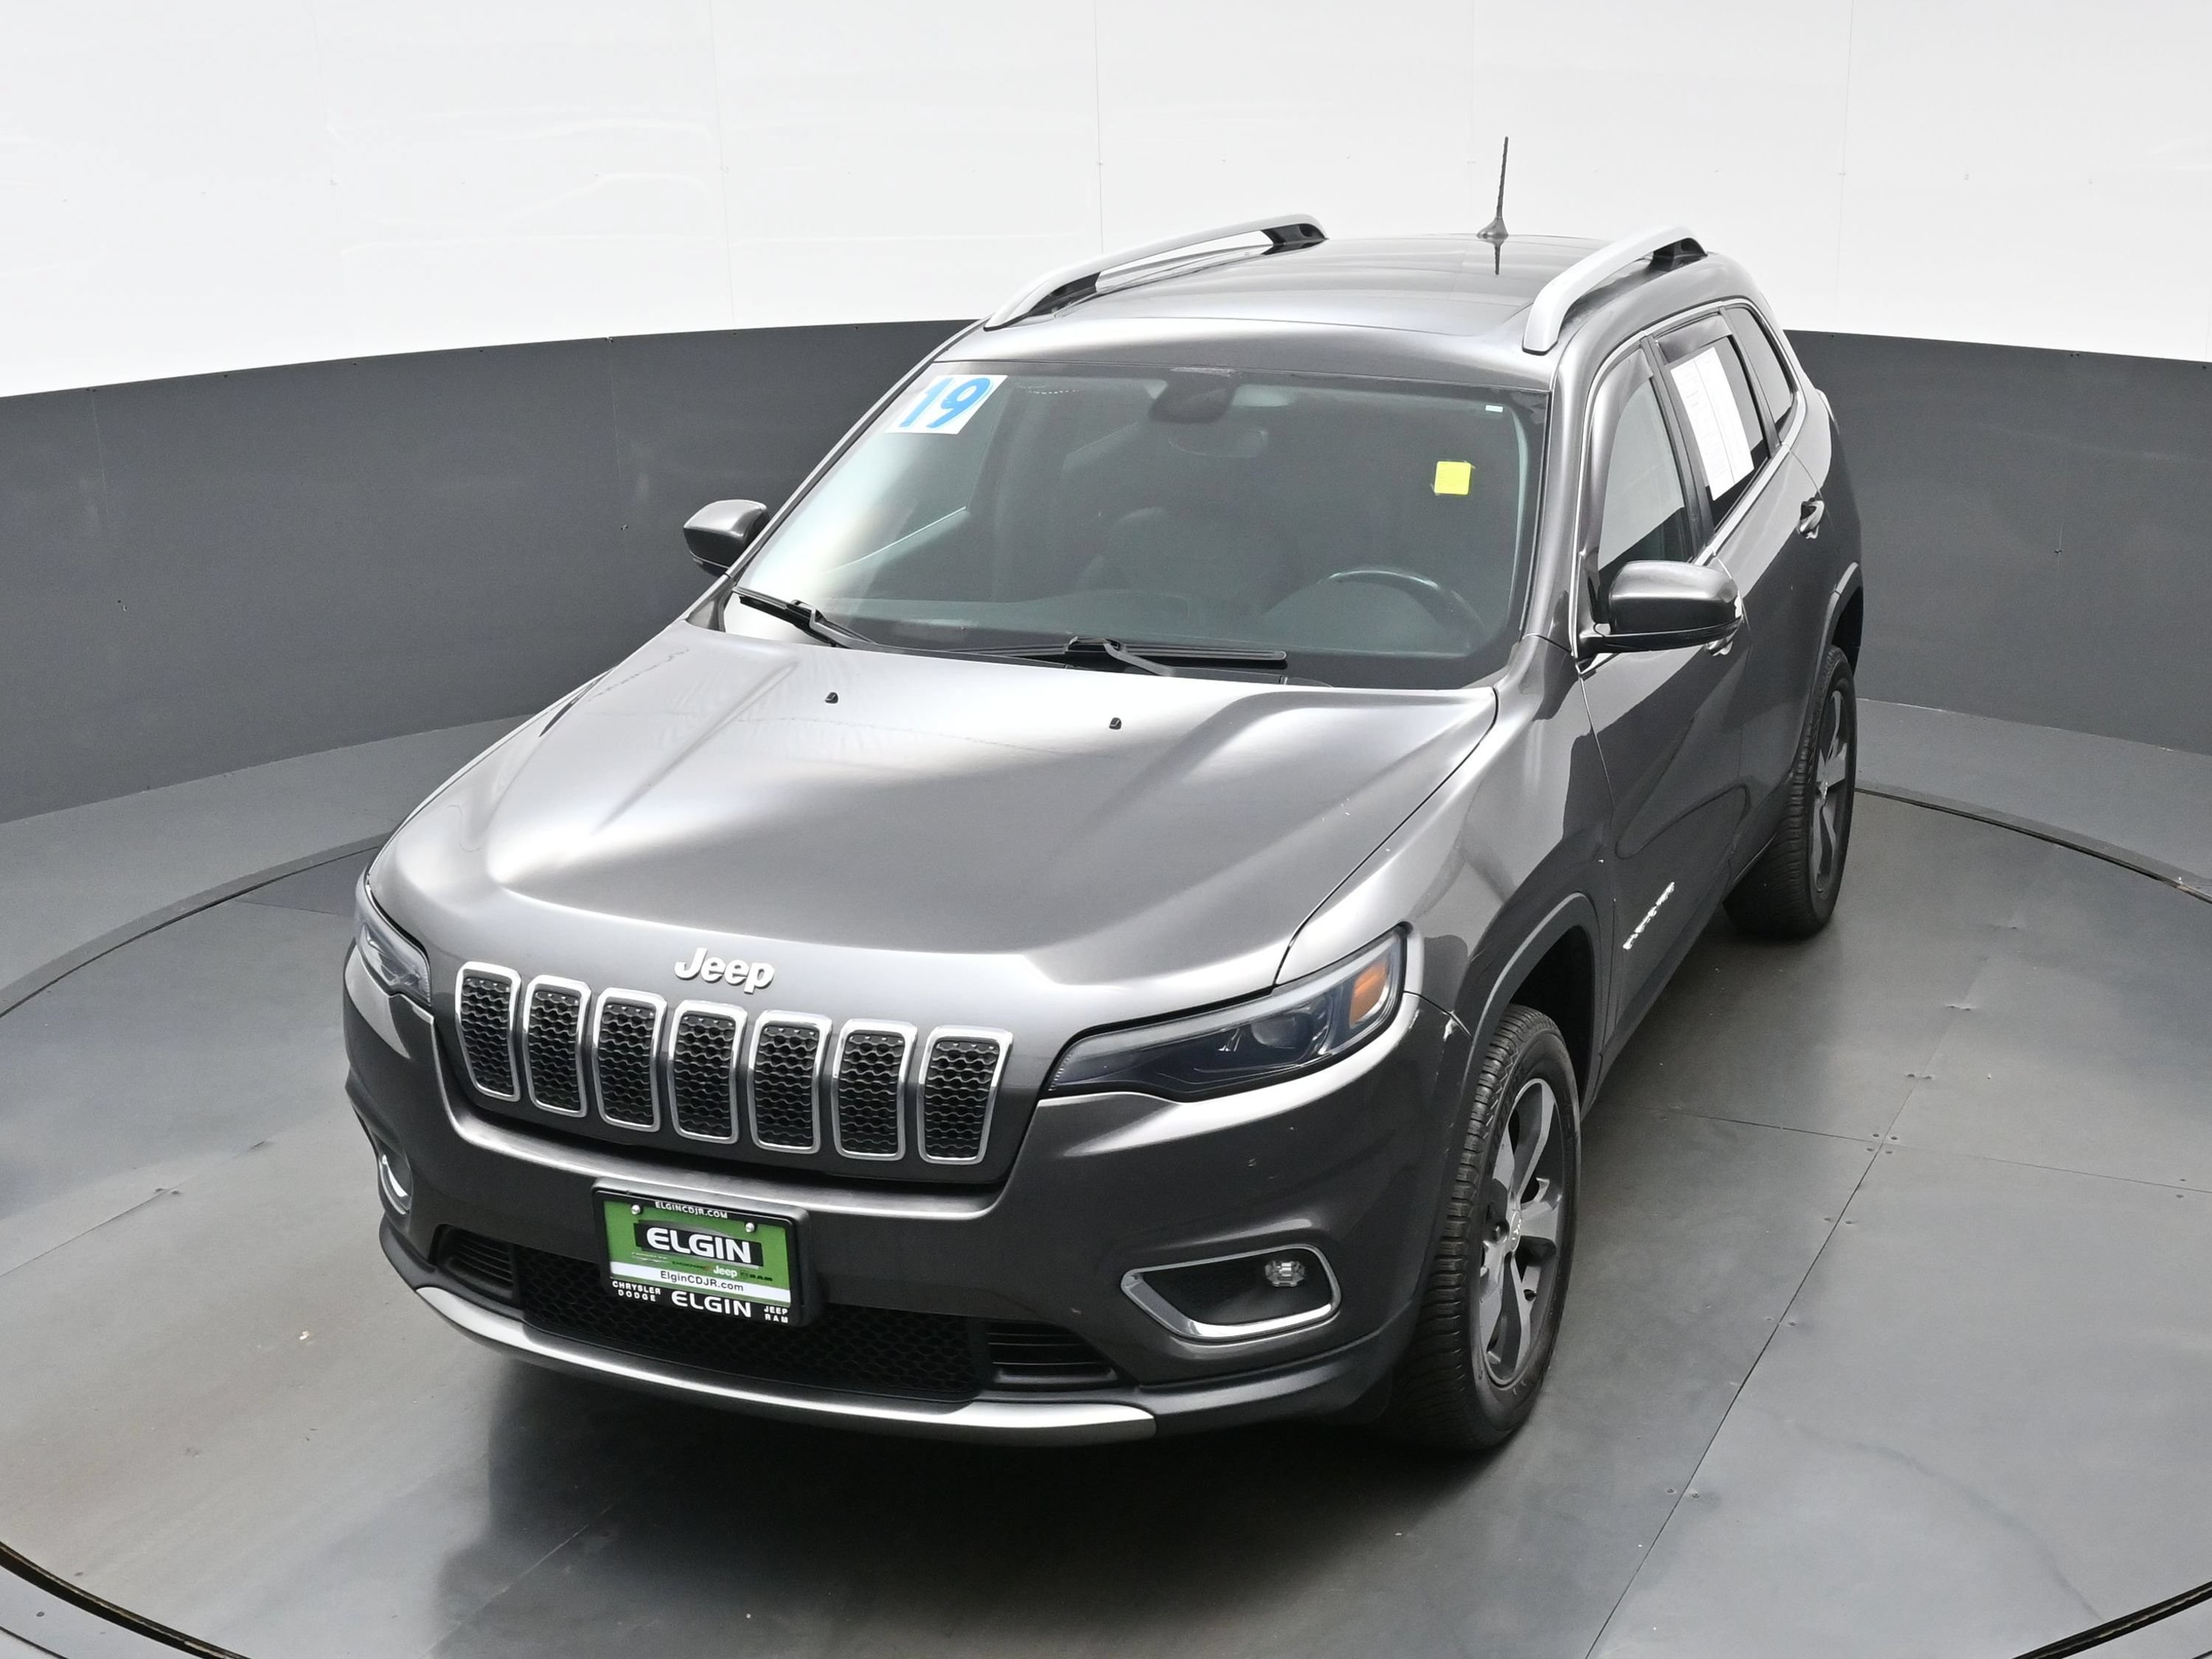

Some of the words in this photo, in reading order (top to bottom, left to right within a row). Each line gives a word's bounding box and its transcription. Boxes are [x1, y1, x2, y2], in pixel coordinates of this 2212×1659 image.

[898, 377, 991, 428] 19
[674, 947, 775, 995] Jeep
[655, 1201, 728, 1219] ELGINCDJR.COM
[646, 1227, 752, 1264] ELGIN
[712, 1265, 738, 1278] Jeep
[612, 1280, 661, 1295] CHRYSLER
[661, 1270, 744, 1292] ElginCDJR.com
[618, 1290, 656, 1302] DODGE
[671, 1290, 752, 1318] ELGIN
[763, 1305, 789, 1315] JEEP
[765, 1314, 789, 1324] RAM
